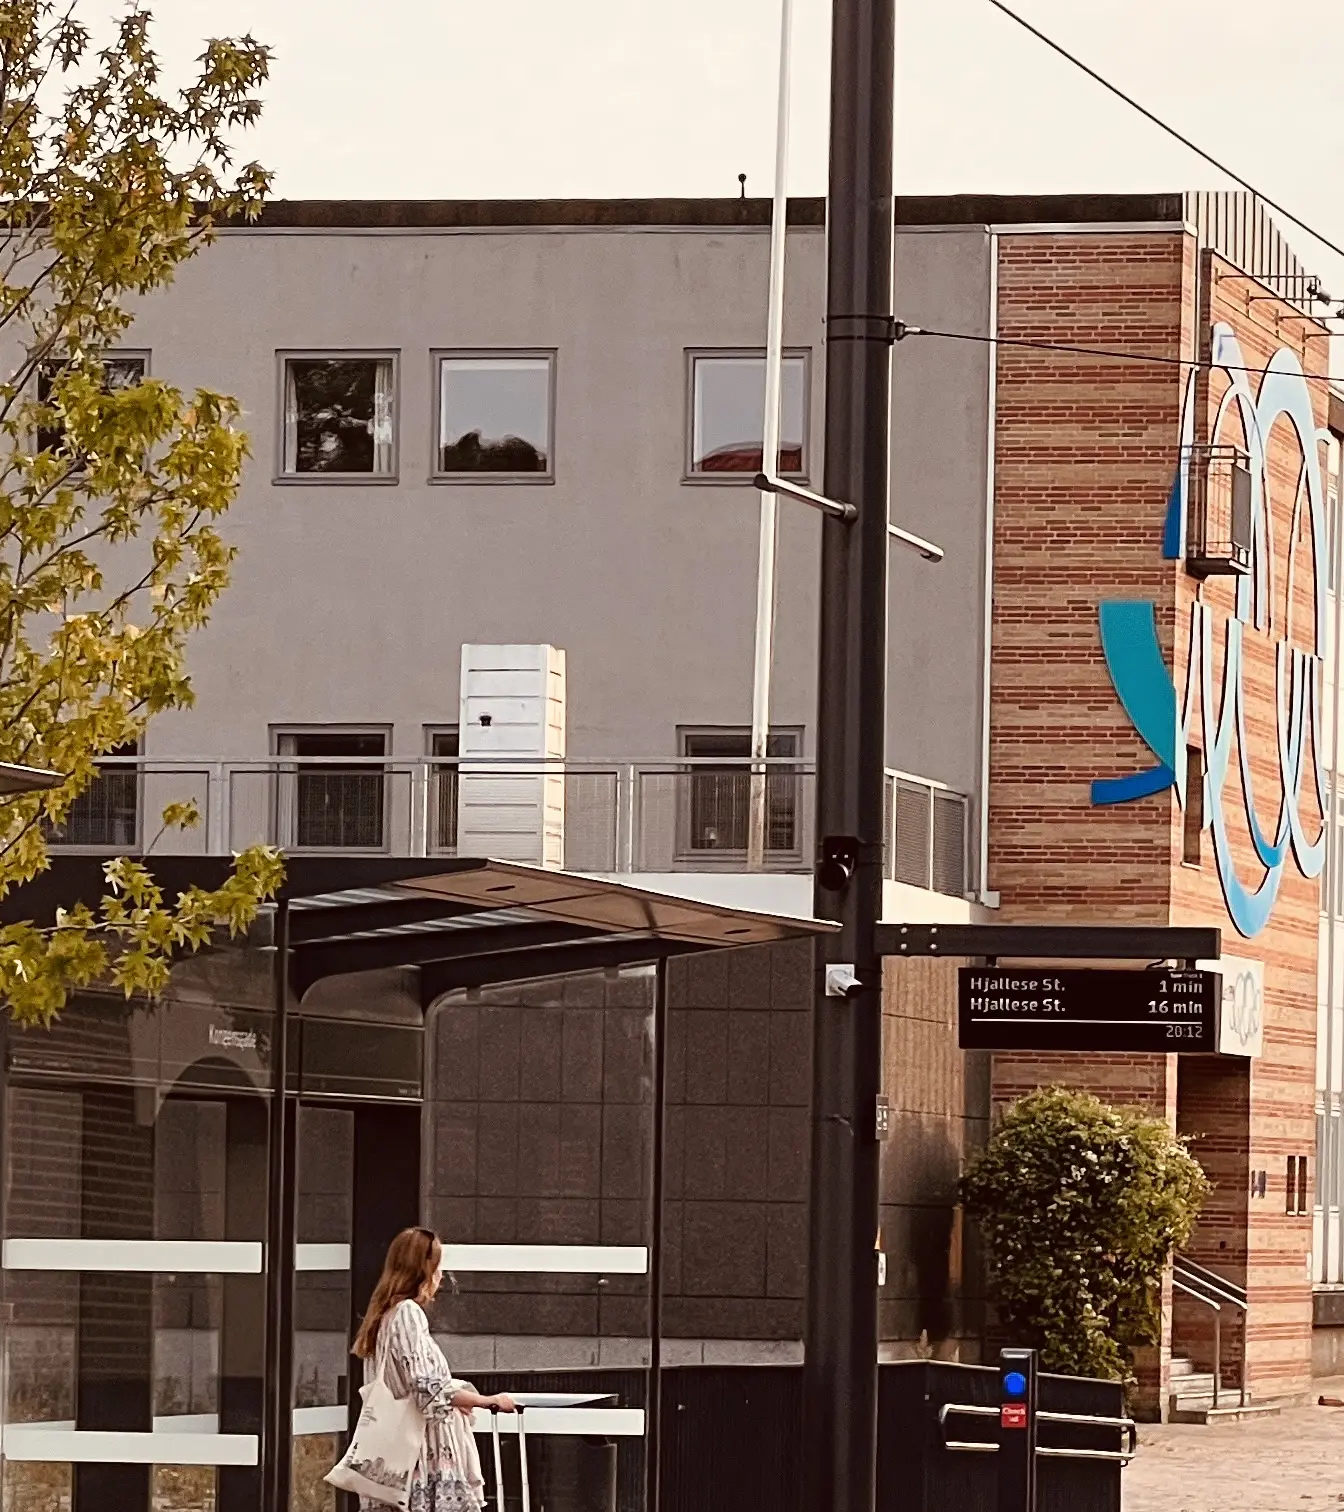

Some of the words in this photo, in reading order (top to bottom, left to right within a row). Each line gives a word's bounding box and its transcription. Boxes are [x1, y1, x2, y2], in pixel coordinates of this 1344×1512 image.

[970, 977, 1038, 993] Hjallese
[1042, 978, 1066, 992] St.
[1159, 980, 1168, 993] 1
[1173, 980, 1203, 994] min
[970, 997, 1038, 1013] Hjallese
[1042, 998, 1066, 1012] St.
[1148, 1000, 1169, 1014] 16
[1173, 1000, 1203, 1014] min
[1165, 1025, 1203, 1038] 20:12
